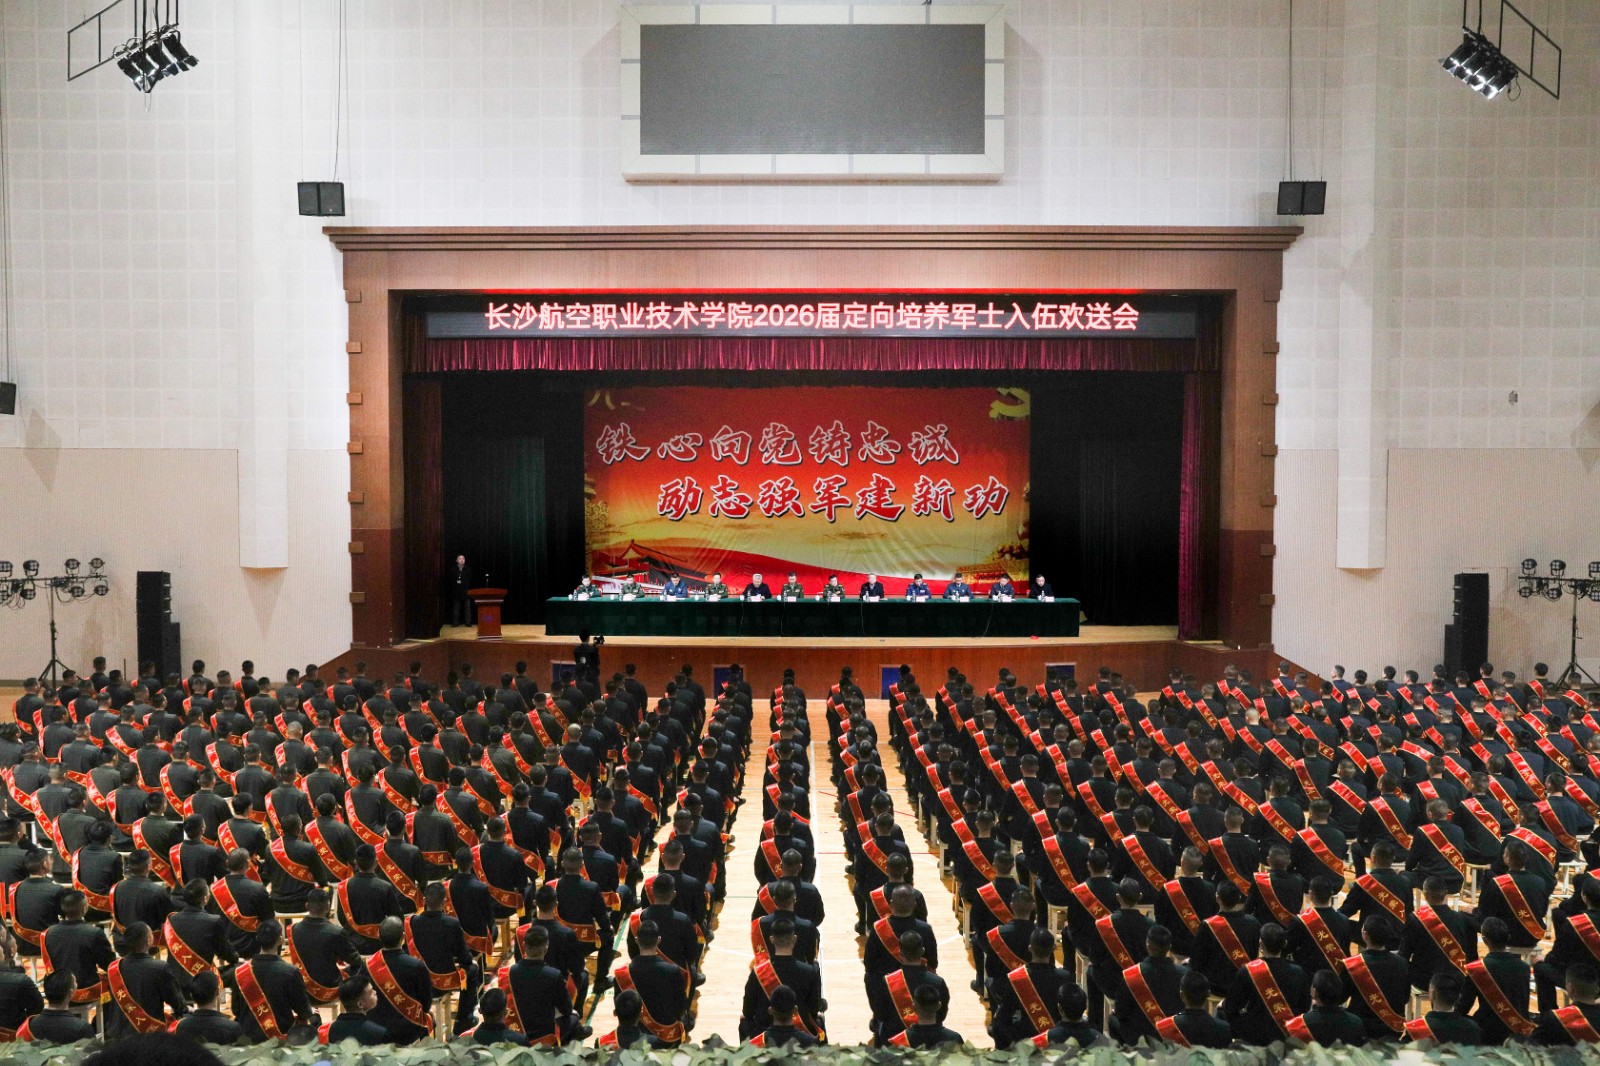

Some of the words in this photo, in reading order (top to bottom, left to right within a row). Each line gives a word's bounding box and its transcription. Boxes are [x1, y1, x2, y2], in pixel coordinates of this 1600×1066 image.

[485, 302, 1139, 331] 长沙航空职业技术学院2026届定向培养军士入伍欢送会
[596, 420, 959, 466] 铁心向党铸忠诚
[658, 474, 1009, 521] 励志强军建新功
